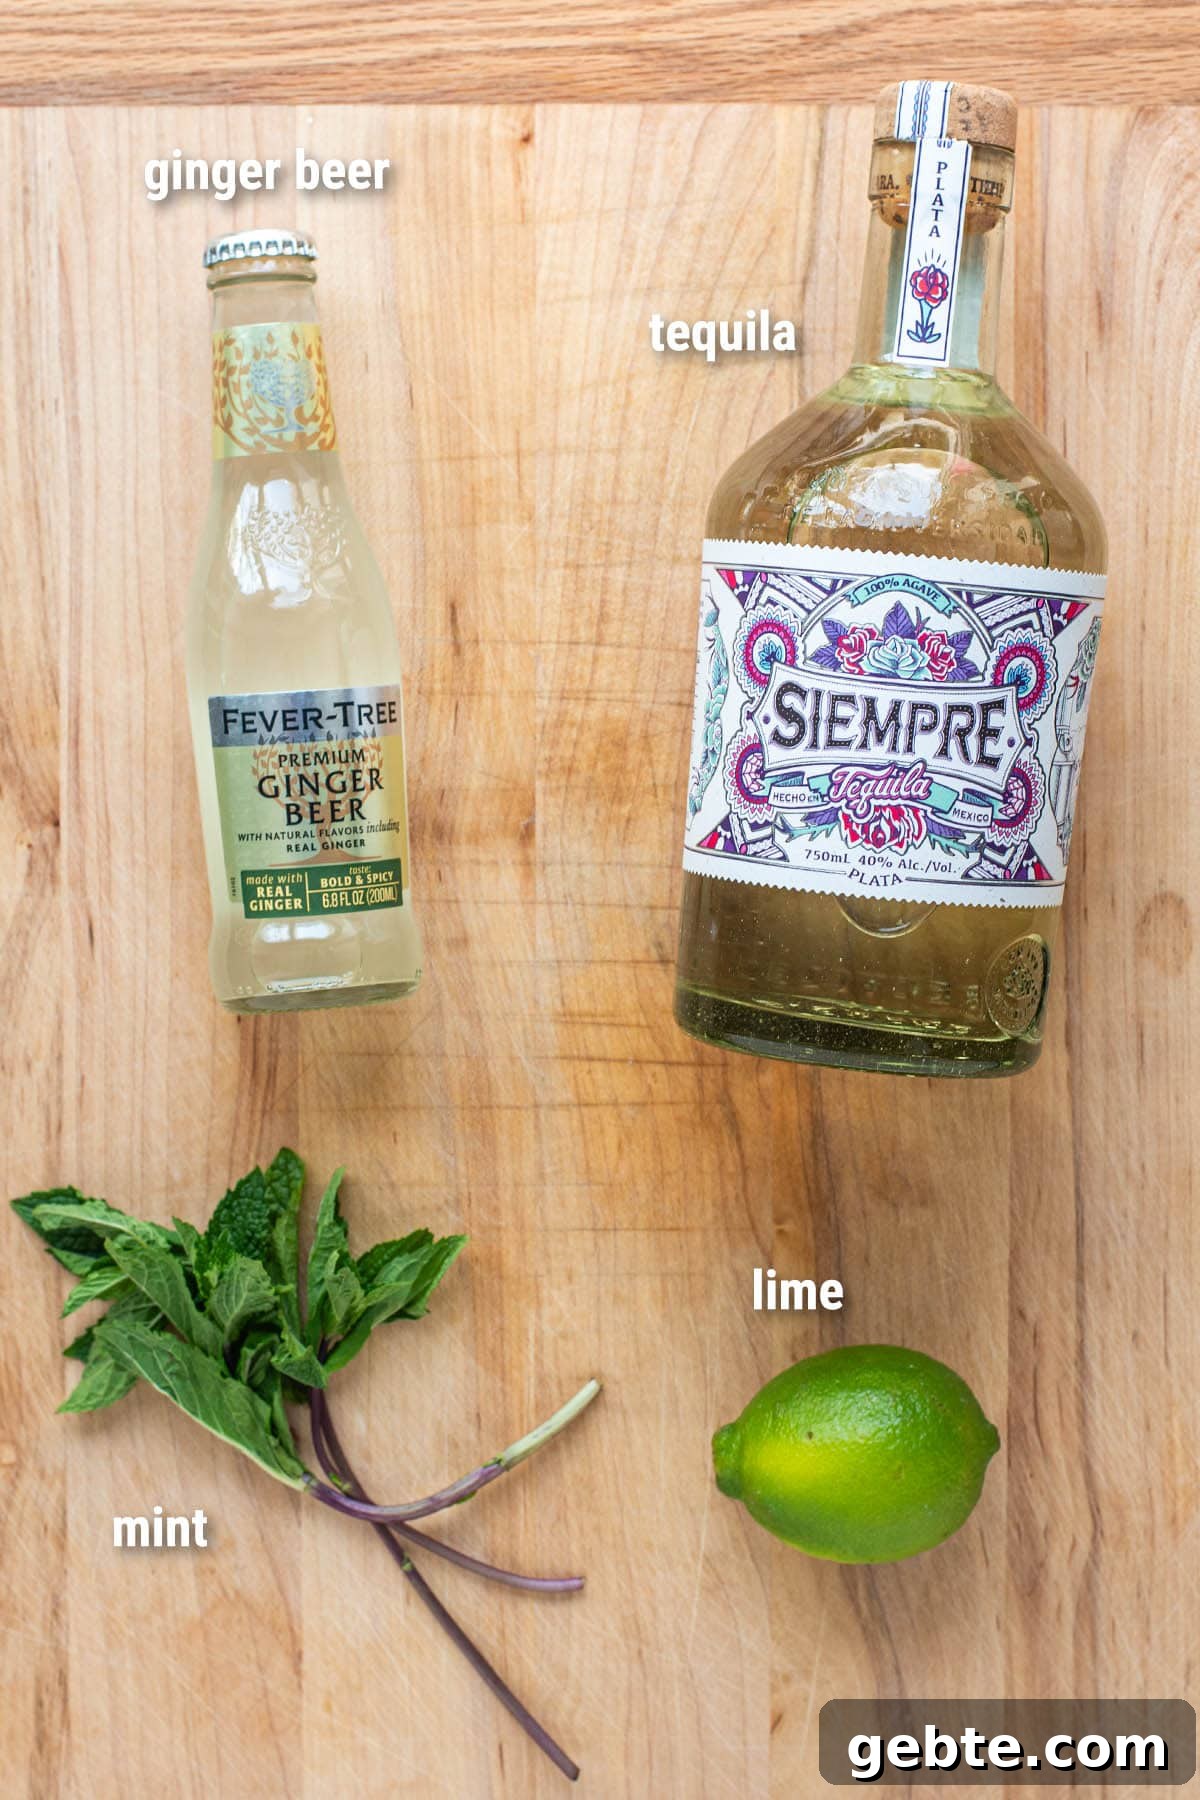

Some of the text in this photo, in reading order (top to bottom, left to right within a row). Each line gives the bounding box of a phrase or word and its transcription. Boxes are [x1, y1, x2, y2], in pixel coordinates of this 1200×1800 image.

[928, 161, 948, 238] PLATA
[863, 577, 941, 602] 100% AGAVE
[222, 701, 398, 735] FEVER-TREE
[769, 681, 1008, 771] SIEMPRE
[278, 748, 366, 768] PREMIUM
[257, 768, 384, 799] GINGER
[830, 760, 933, 821] Tequila
[772, 792, 820, 803] HECHO EN
[285, 798, 367, 826] BEER
[952, 807, 989, 823] MEXICO
[238, 819, 401, 842] WITH NATURAL FLAVORS including
[286, 838, 366, 853] REAL GINGER
[804, 849, 957, 874] 750mL 40% Alc./Vol.
[245, 873, 303, 885] made with
[320, 871, 394, 889] BOLD & SPICY
[848, 868, 903, 887] PLATA
[256, 886, 293, 898] REAL
[322, 892, 338, 909] 6.8
[352, 890, 365, 905] OZ
[366, 886, 398, 905] (200ML)
[249, 898, 303, 912] GINGER
